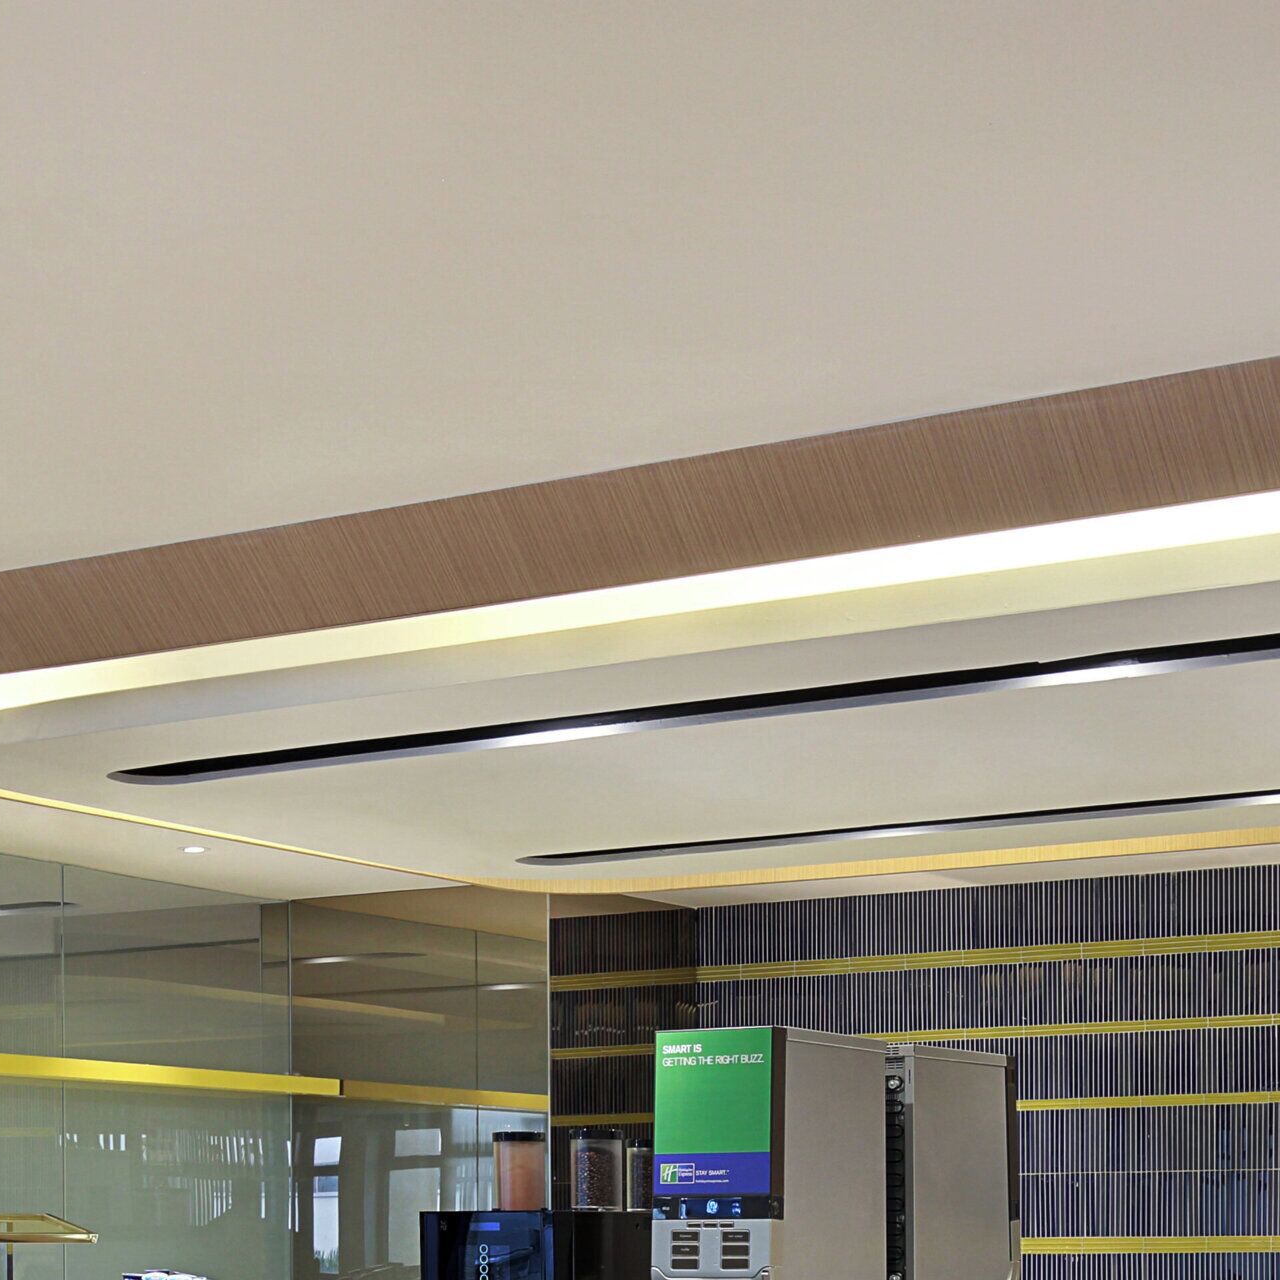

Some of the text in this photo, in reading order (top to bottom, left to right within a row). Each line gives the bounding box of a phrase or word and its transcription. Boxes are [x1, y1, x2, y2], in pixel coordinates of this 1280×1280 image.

[662, 1044, 702, 1054] SMART IS
[662, 1056, 696, 1067] GETTING
[698, 1055, 714, 1065] THE
[715, 1054, 739, 1064] RIGHT
